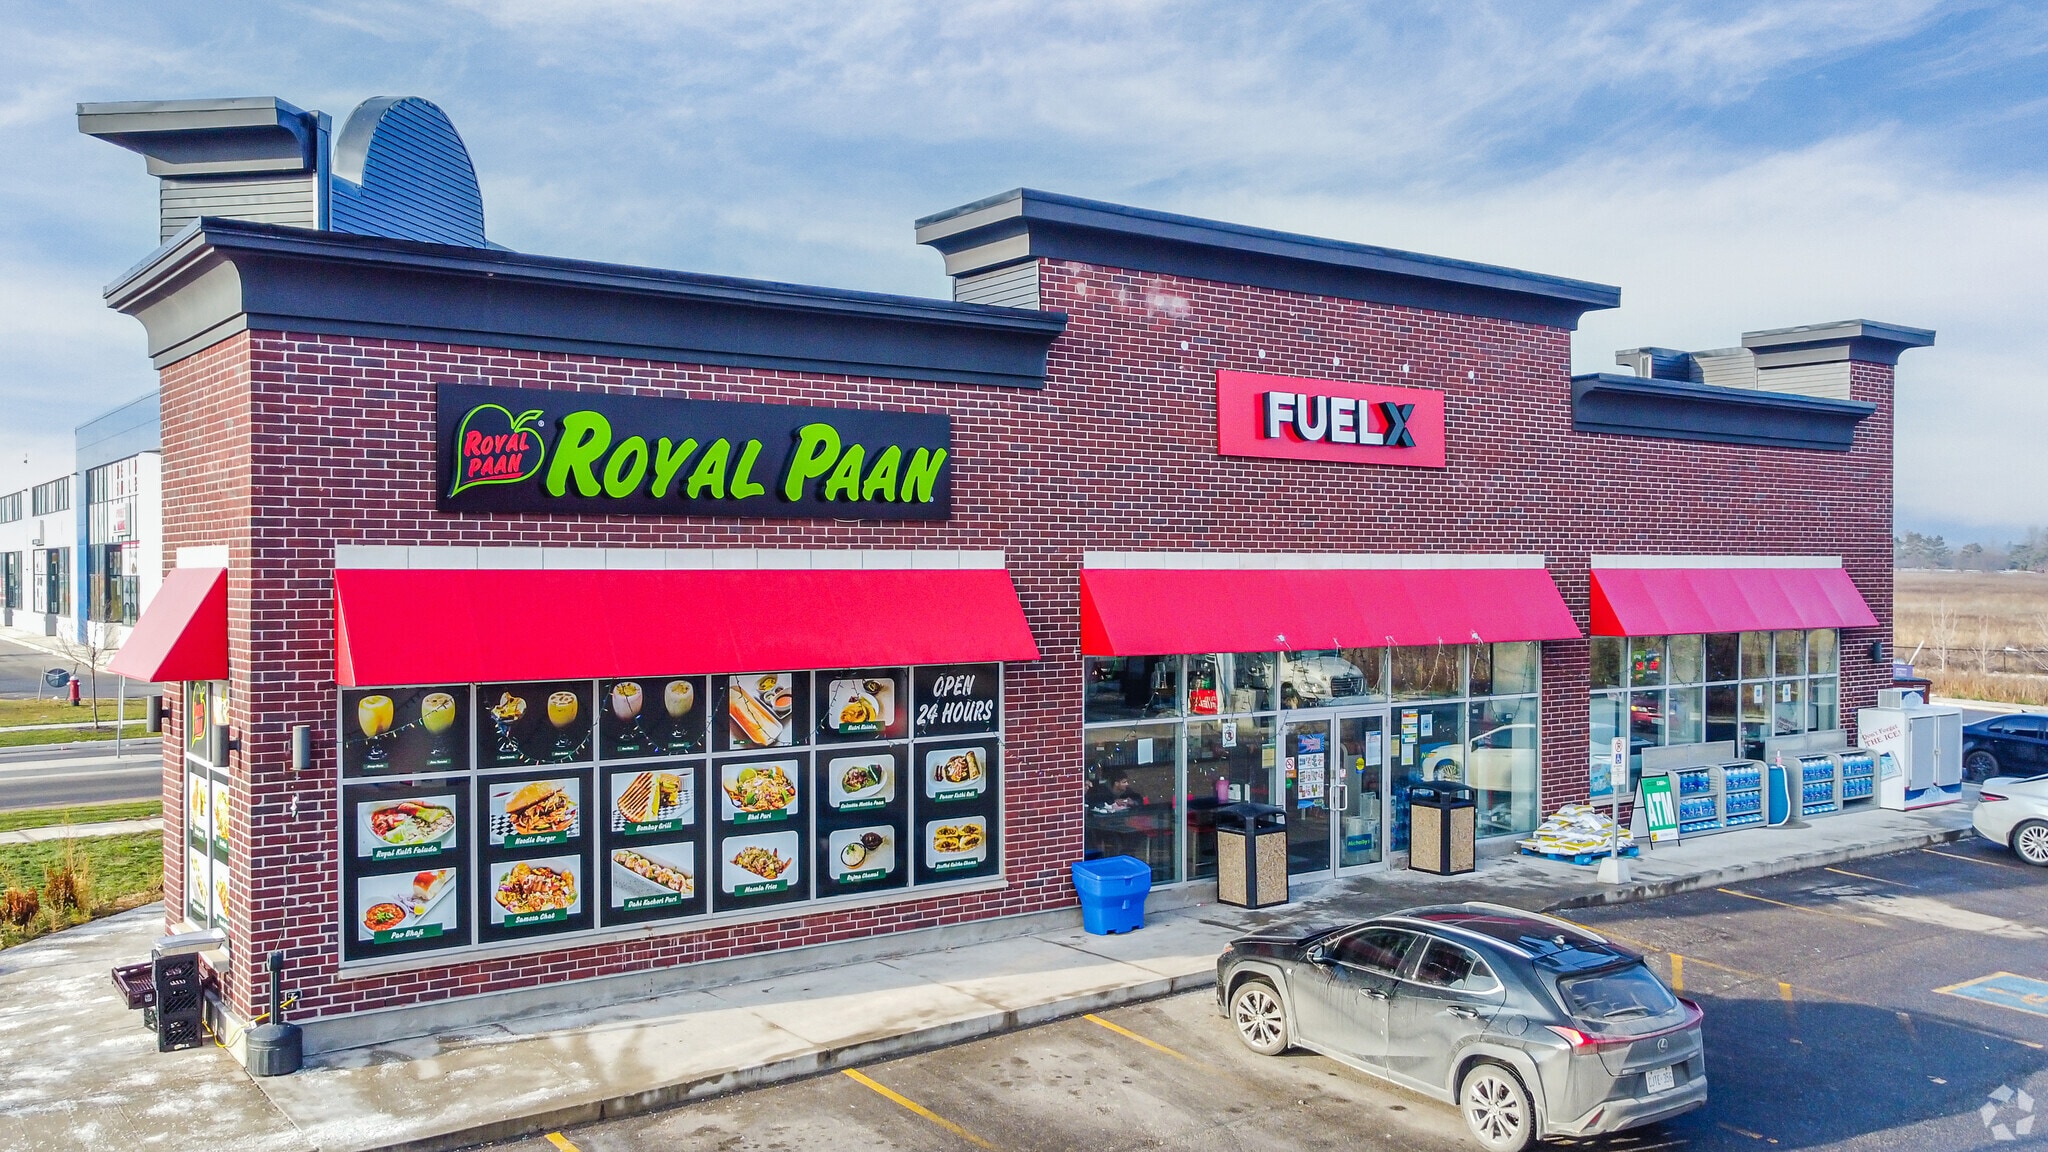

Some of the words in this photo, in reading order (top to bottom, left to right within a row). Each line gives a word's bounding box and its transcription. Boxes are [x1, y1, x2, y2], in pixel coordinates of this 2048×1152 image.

[463, 430, 530, 457] ROYAL
[467, 453, 523, 478] PAAN
[546, 410, 765, 499] ROYAL
[784, 422, 947, 503] PAAN
[933, 674, 976, 697] OPEN
[916, 703, 939, 725] 24
[941, 699, 994, 723] HOURS
[1864, 735, 1884, 747] THE
[1646, 791, 1676, 827] ATM
[658, 821, 672, 830] Grill
[535, 834, 557, 844] Burger
[375, 848, 395, 859] Royal
[413, 844, 438, 854] Faluda
[515, 915, 539, 924] Samosa
